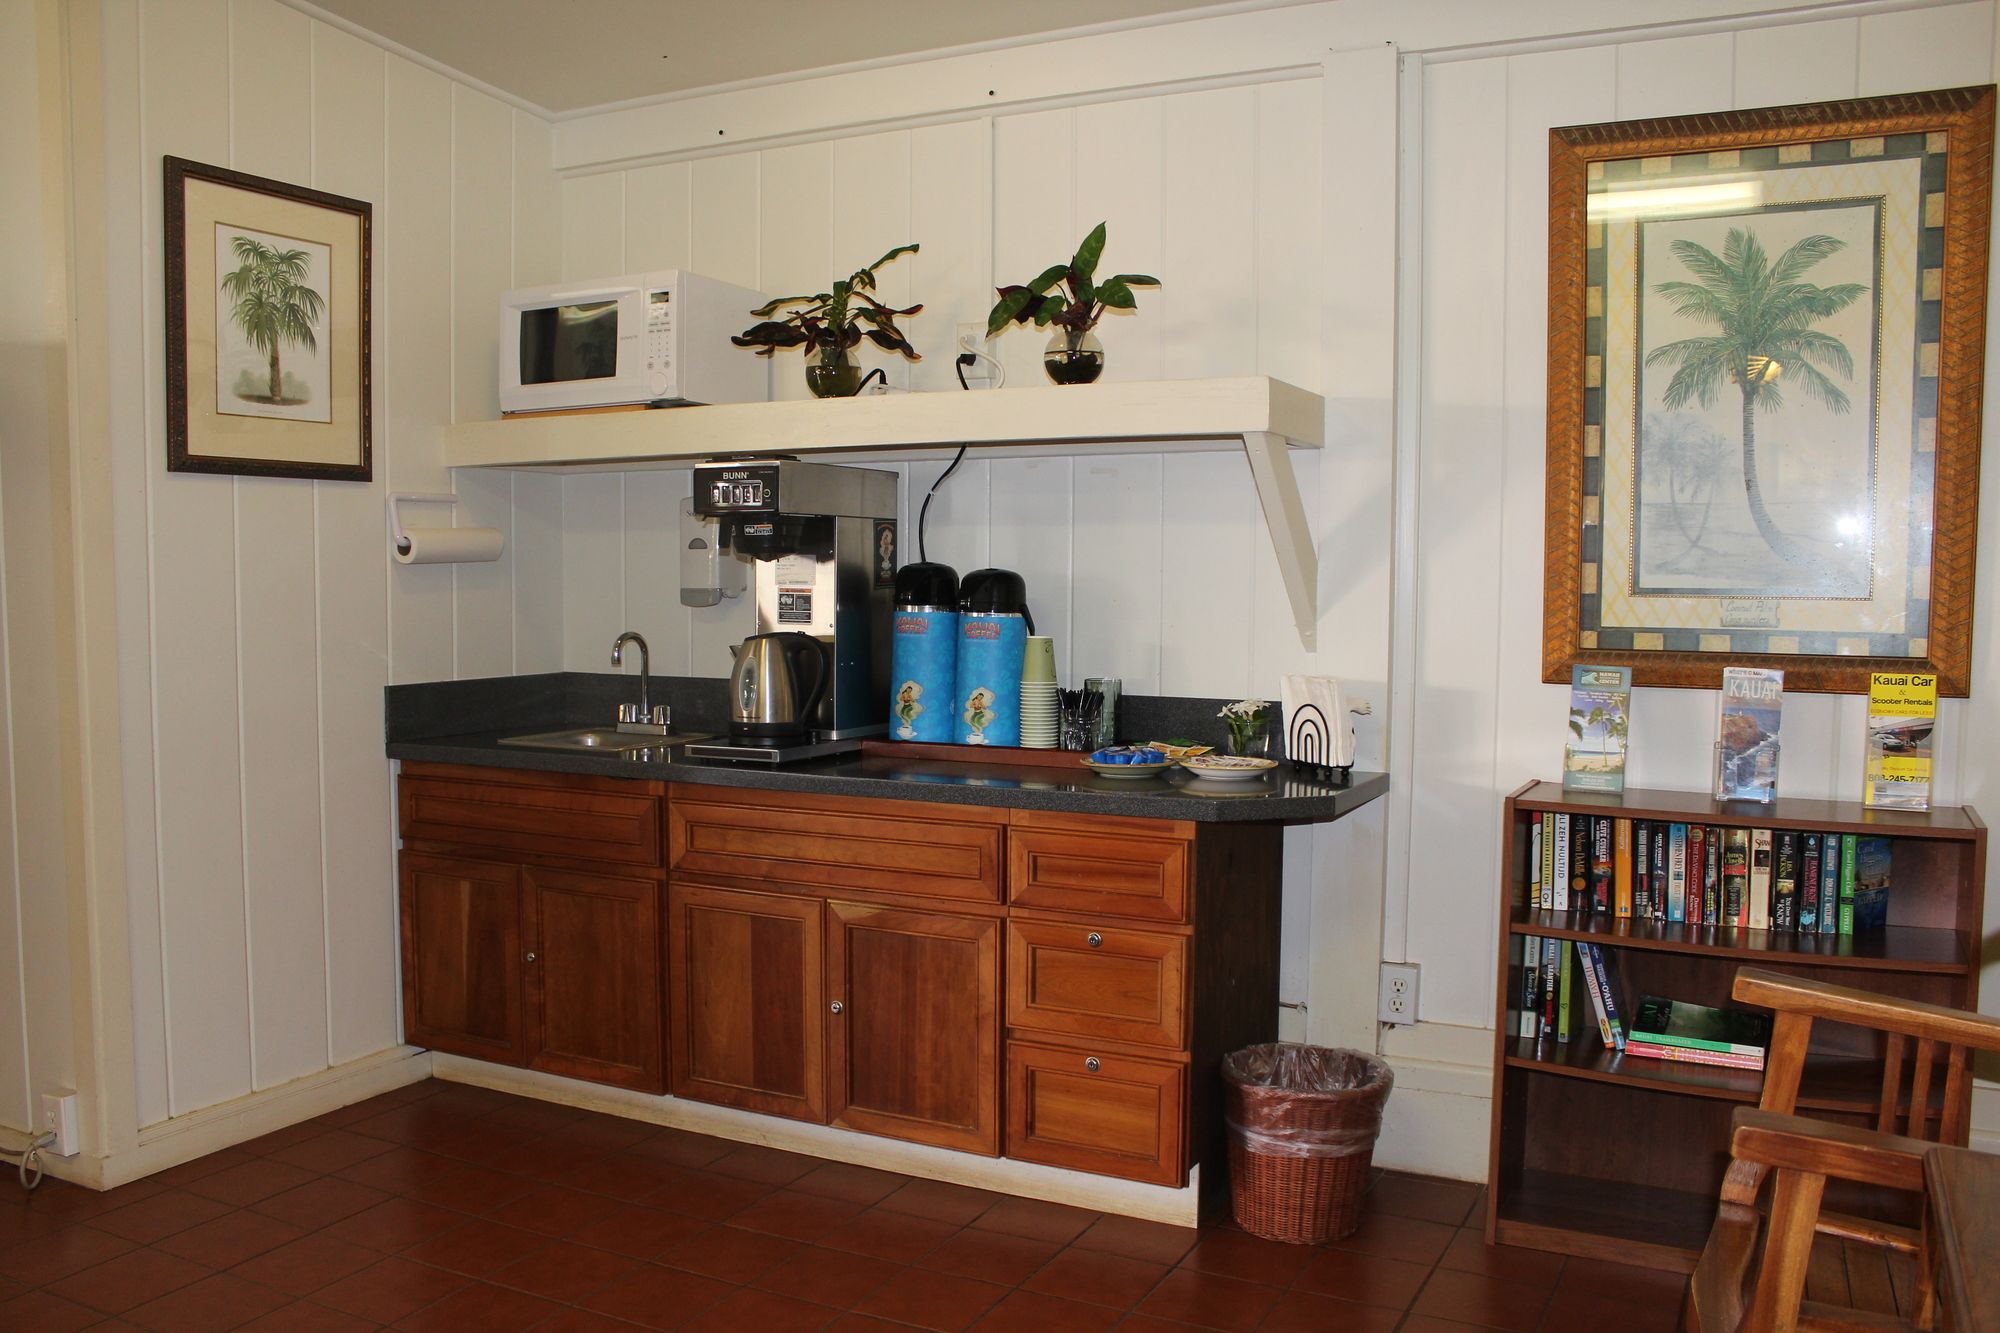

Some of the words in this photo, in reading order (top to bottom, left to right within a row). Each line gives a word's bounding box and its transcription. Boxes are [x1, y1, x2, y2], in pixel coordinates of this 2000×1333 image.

[722, 472, 747, 480] BUNN
[1873, 675, 1908, 686] Kauai
[1911, 675, 1934, 687] Car
[1872, 697, 1902, 705] Scooter
[1903, 698, 1933, 706] Rentals
[1599, 820, 1607, 837] CLIVE
[1575, 832, 1585, 852] Nelson
[1599, 838, 1607, 862] CUSSLER
[1558, 845, 1566, 879] NULTIJD
[1574, 853, 1585, 876] DeMille
[1779, 854, 1787, 878] JACKSON
[1785, 896, 1793, 906] YOU
[1776, 903, 1784, 925] KNOW
[1585, 966, 1600, 1000] HAWAII
